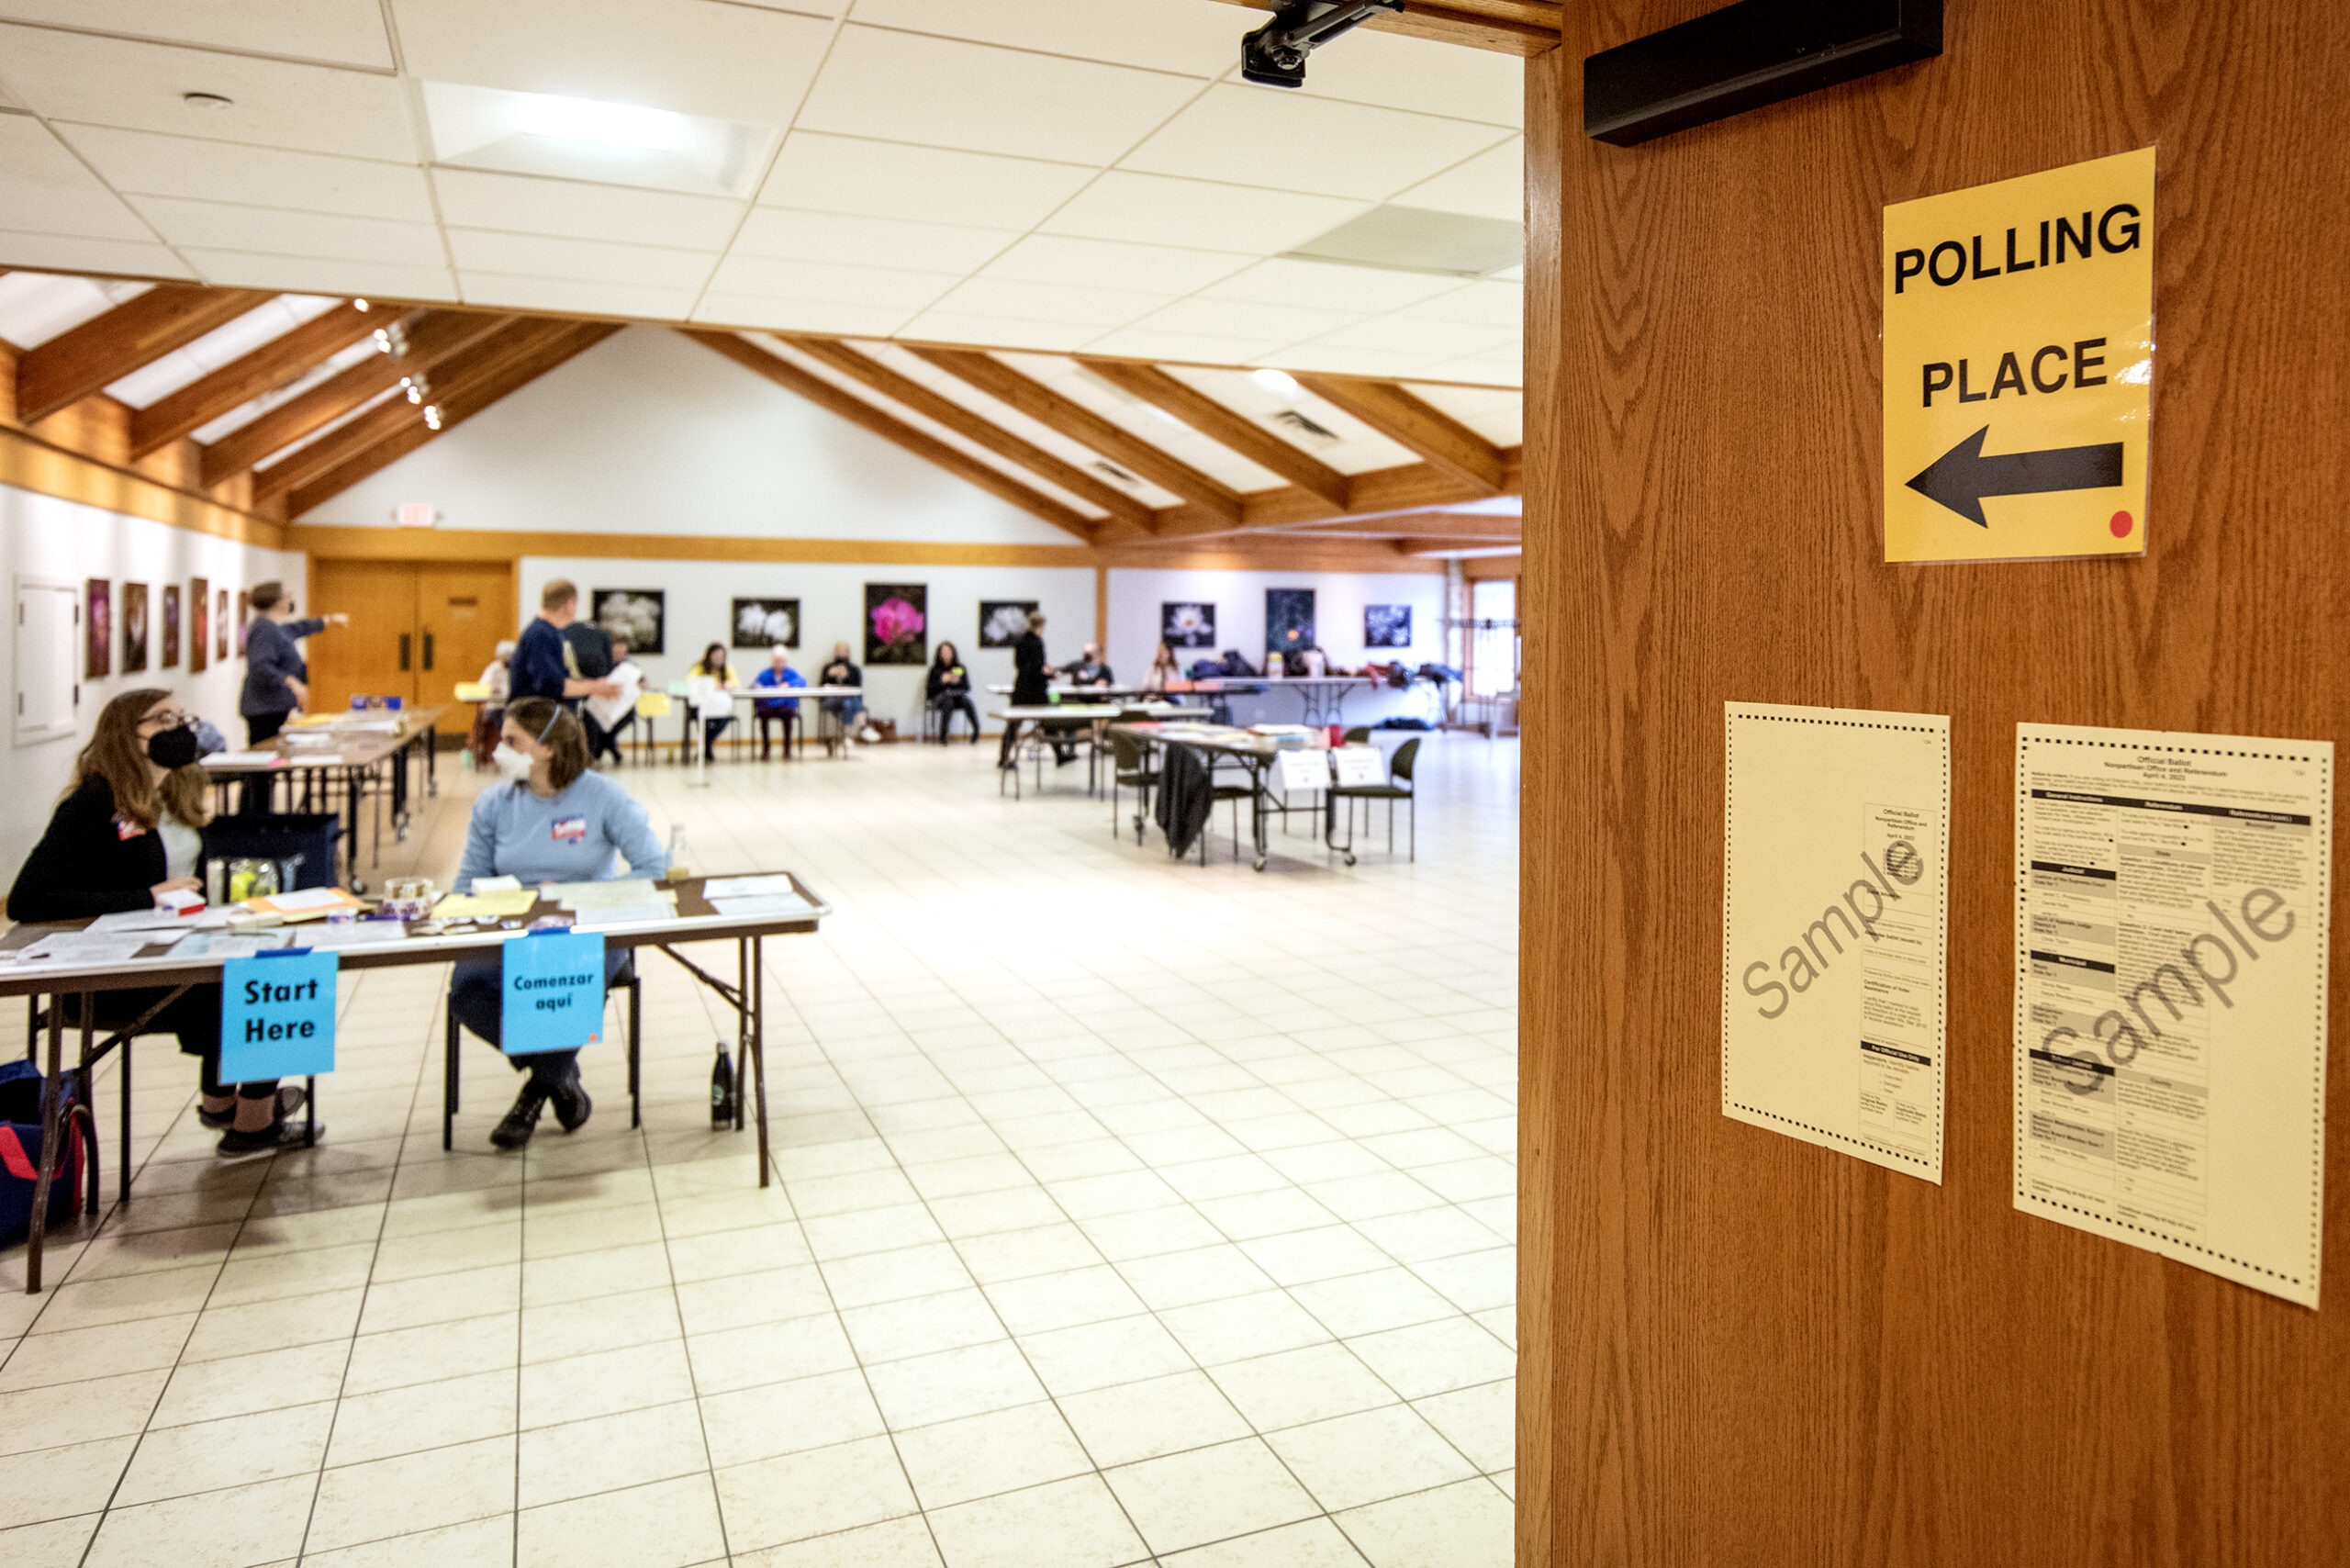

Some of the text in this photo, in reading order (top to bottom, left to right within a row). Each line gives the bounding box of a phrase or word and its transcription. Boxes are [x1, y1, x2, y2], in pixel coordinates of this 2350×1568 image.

[1895, 203, 2142, 295] POLLING
[1922, 337, 2109, 408] PLACE
[2137, 756, 2165, 765] Official
[1742, 840, 1924, 1020] Sample
[244, 979, 319, 1004] Start
[514, 972, 595, 991] Comenzar
[2041, 888, 2296, 1095] Sample
[244, 1019, 316, 1043] Here
